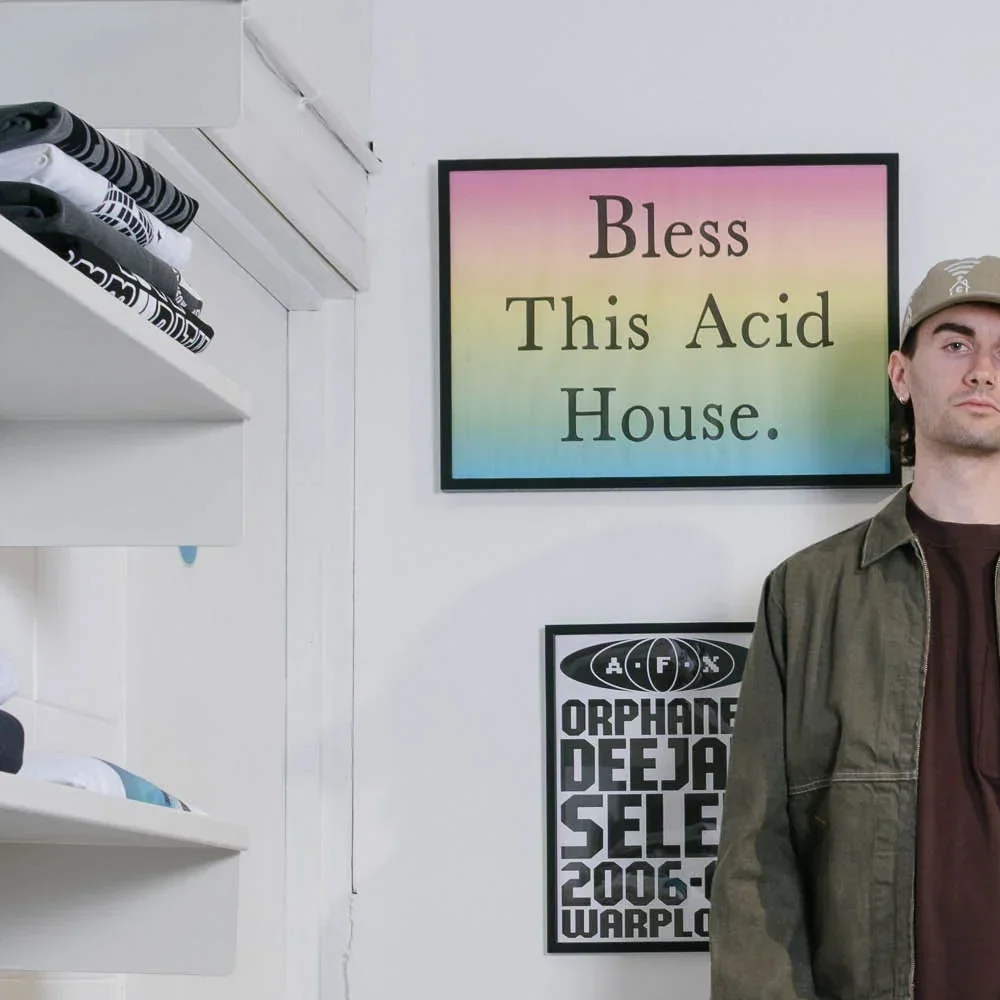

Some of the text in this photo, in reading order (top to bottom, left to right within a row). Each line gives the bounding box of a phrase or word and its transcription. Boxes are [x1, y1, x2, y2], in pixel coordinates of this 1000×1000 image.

[588, 195, 749, 259] Bless
[505, 290, 834, 352] This Acid
[560, 387, 779, 442] House.
[560, 737, 733, 792] DEEJA
[560, 793, 725, 859] SELE
